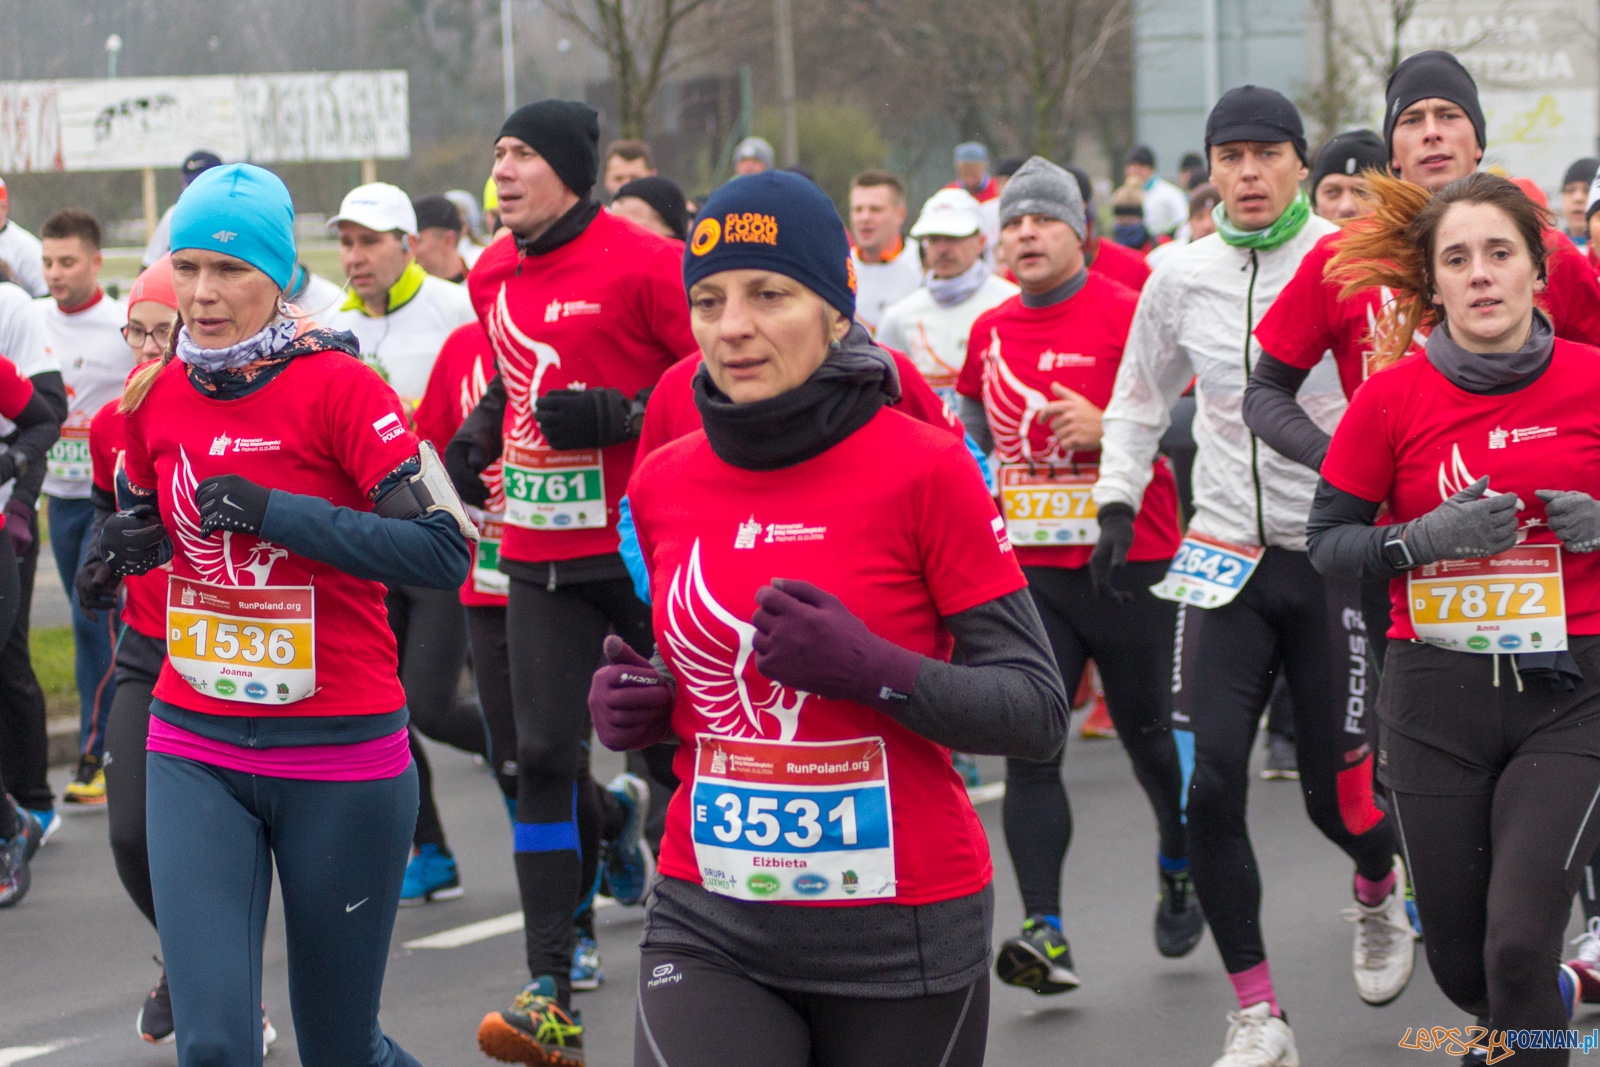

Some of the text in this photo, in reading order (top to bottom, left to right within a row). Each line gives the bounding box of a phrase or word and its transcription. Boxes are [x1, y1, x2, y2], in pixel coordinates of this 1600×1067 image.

[725, 212, 775, 224] GLOBAL
[724, 221, 779, 236] FOOD
[724, 232, 778, 246] HYGIENE
[382, 427, 406, 444] POLSKA
[45, 442, 92, 461] 090
[512, 471, 587, 501] 3761
[1014, 491, 1091, 518] 3797
[1171, 544, 1243, 586] 2642
[1489, 558, 1549, 567] RunPoland.org
[239, 601, 301, 612] RunPoland.org
[1414, 582, 1547, 620] D 7872
[171, 619, 296, 666] D 1536
[220, 666, 253, 678] Joanna
[1344, 634, 1369, 735] FOCUS
[786, 760, 870, 774] RunPoland.org
[696, 792, 858, 848] E 3531
[753, 857, 807, 868] Elżbieta
[704, 867, 726, 879] GRUPA
[647, 972, 683, 988] Kalenji
